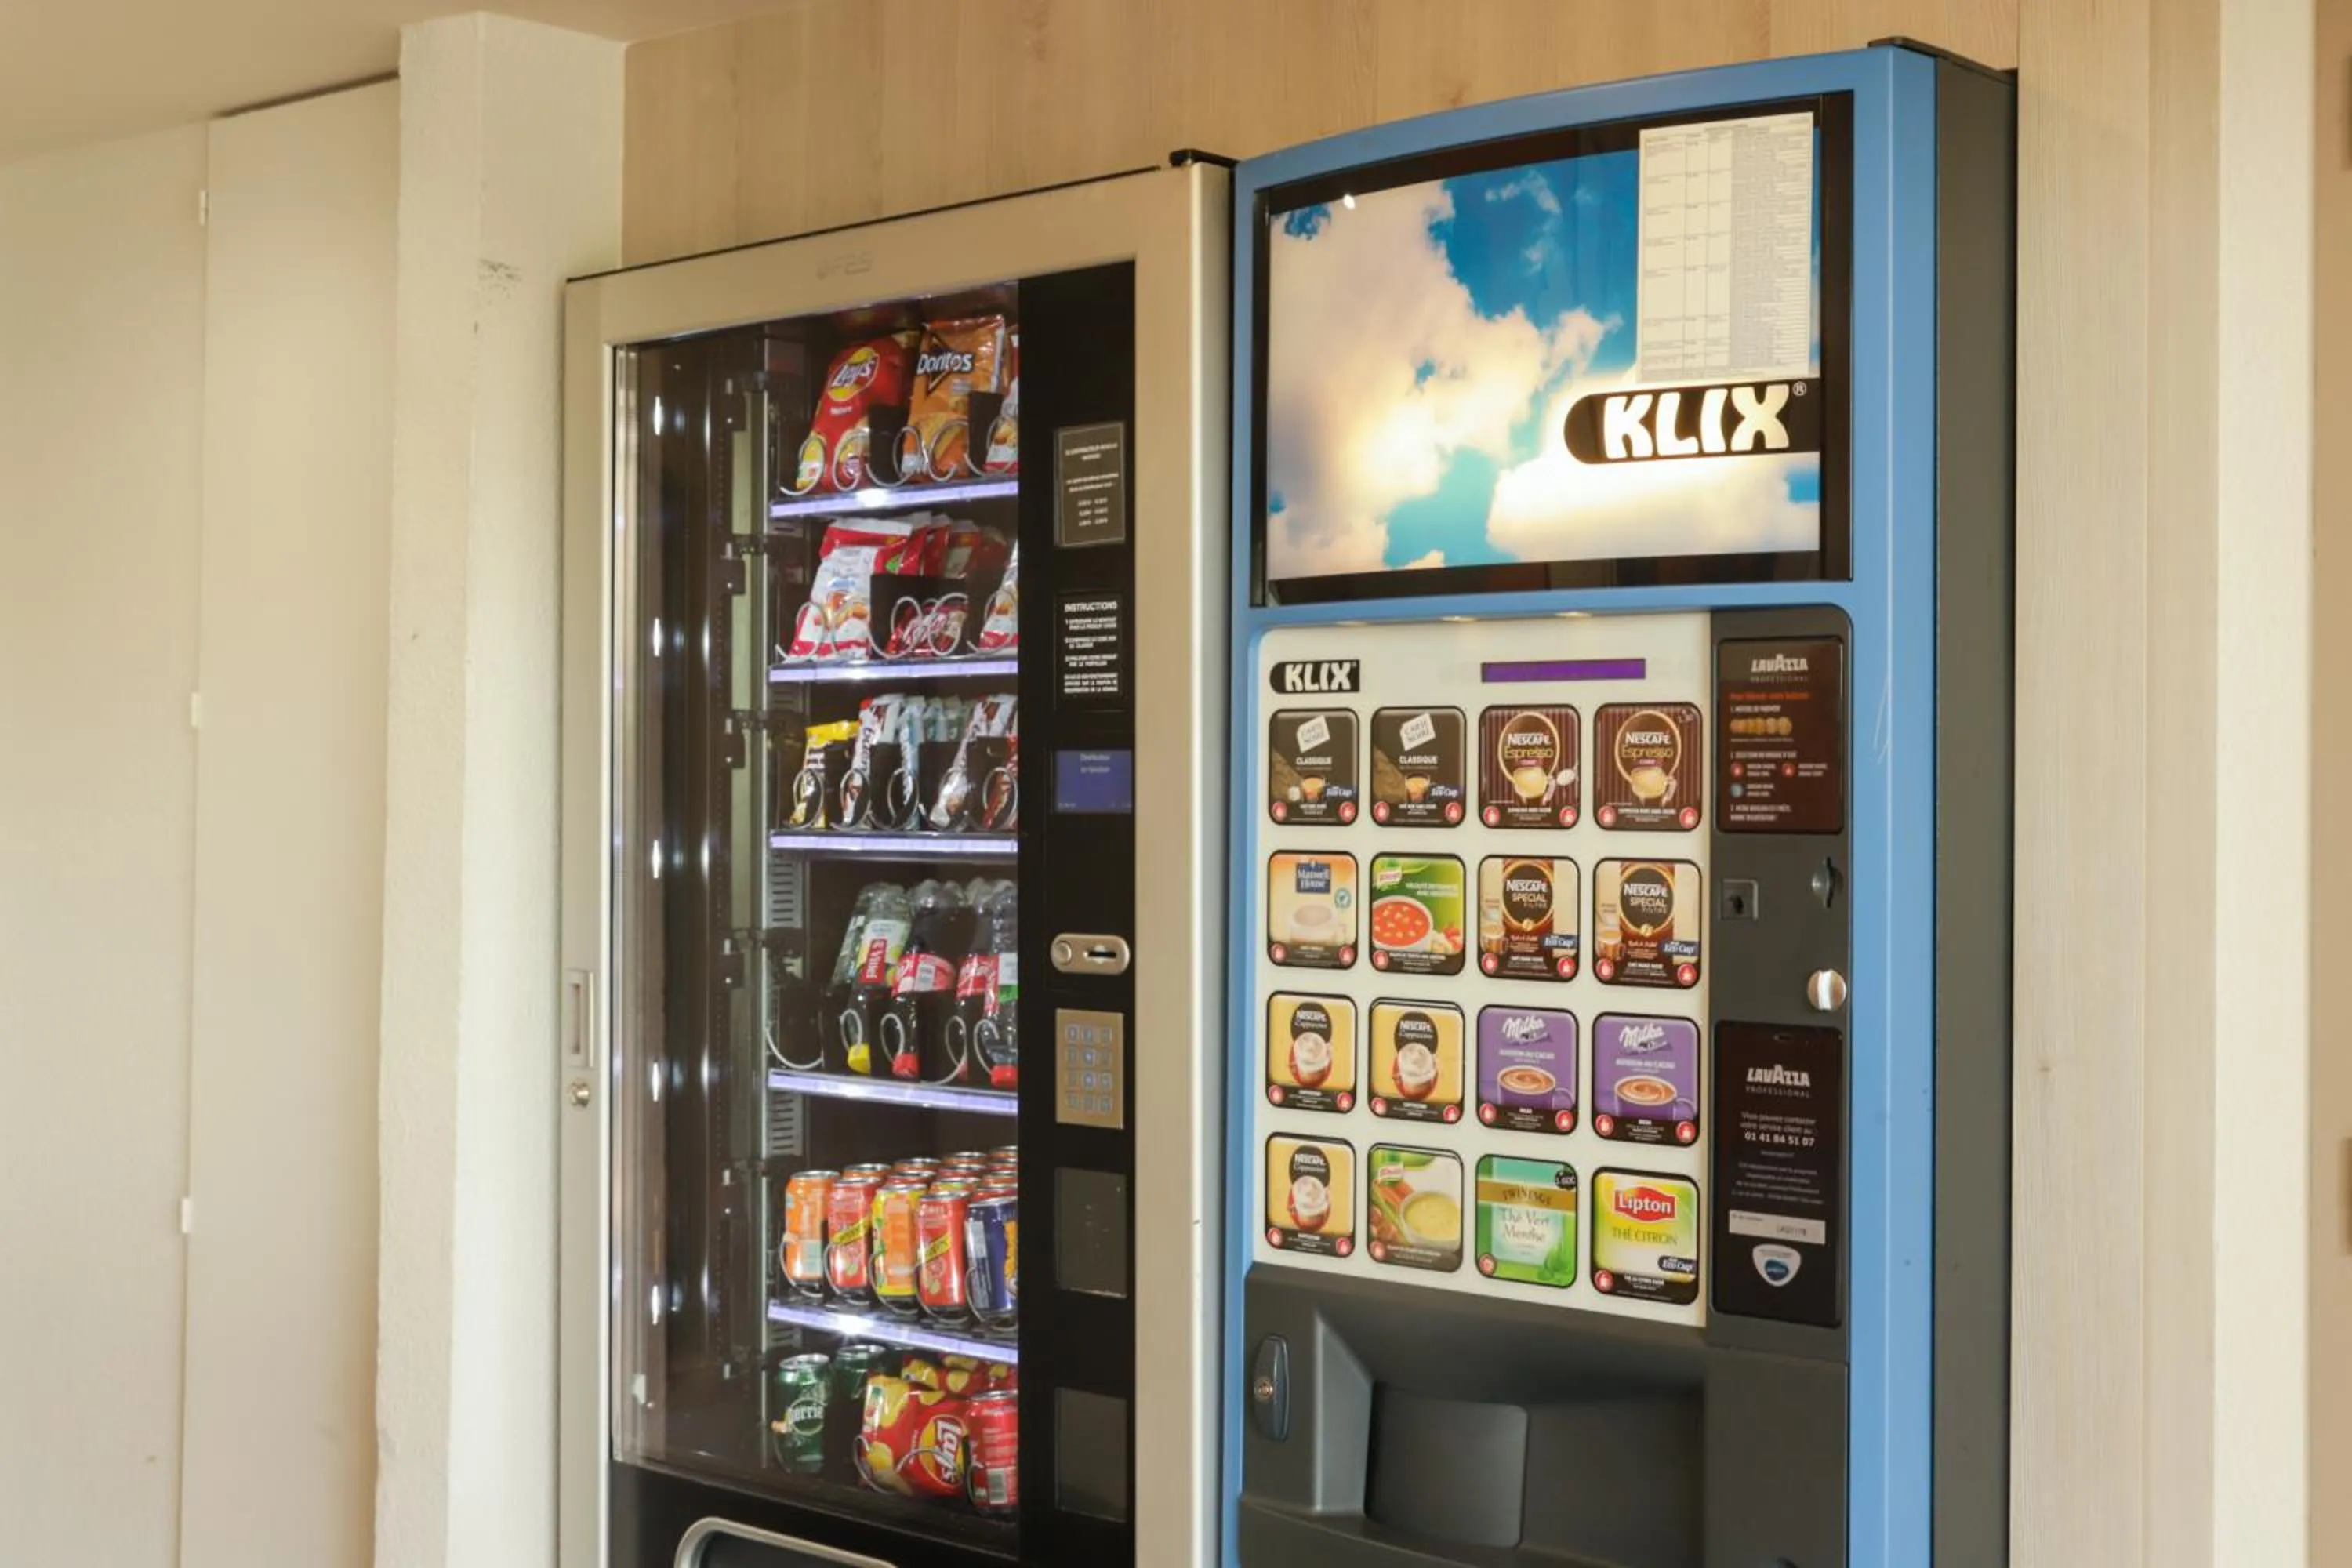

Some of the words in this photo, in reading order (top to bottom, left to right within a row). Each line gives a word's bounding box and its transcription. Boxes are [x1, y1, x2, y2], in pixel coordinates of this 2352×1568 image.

[916, 354, 973, 375] Doritos
[1603, 383, 1790, 459] KLIX
[1751, 653, 1809, 673] LAVAZZA
[1285, 662, 1351, 692] KLIX
[1399, 755, 1438, 764] CLASSIQUE
[1504, 747, 1554, 760] Espresso
[1621, 745, 1674, 759] Espresso
[1502, 1016, 1546, 1039] Milka
[1619, 1024, 1664, 1047] Milka
[1746, 1063, 1810, 1087] LAVAZZA
[1745, 1086, 1810, 1098] PROFESSIONAL
[1744, 1131, 1756, 1141] 01
[1759, 1132, 1770, 1142] 41
[1802, 1137, 1815, 1146] 07
[1618, 1191, 1671, 1214] Lipton
[1526, 1210, 1550, 1225] Vert
[1503, 1223, 1545, 1242] Menthe
[1634, 1229, 1678, 1245] CITRON
[1678, 1261, 1693, 1272] Cup
